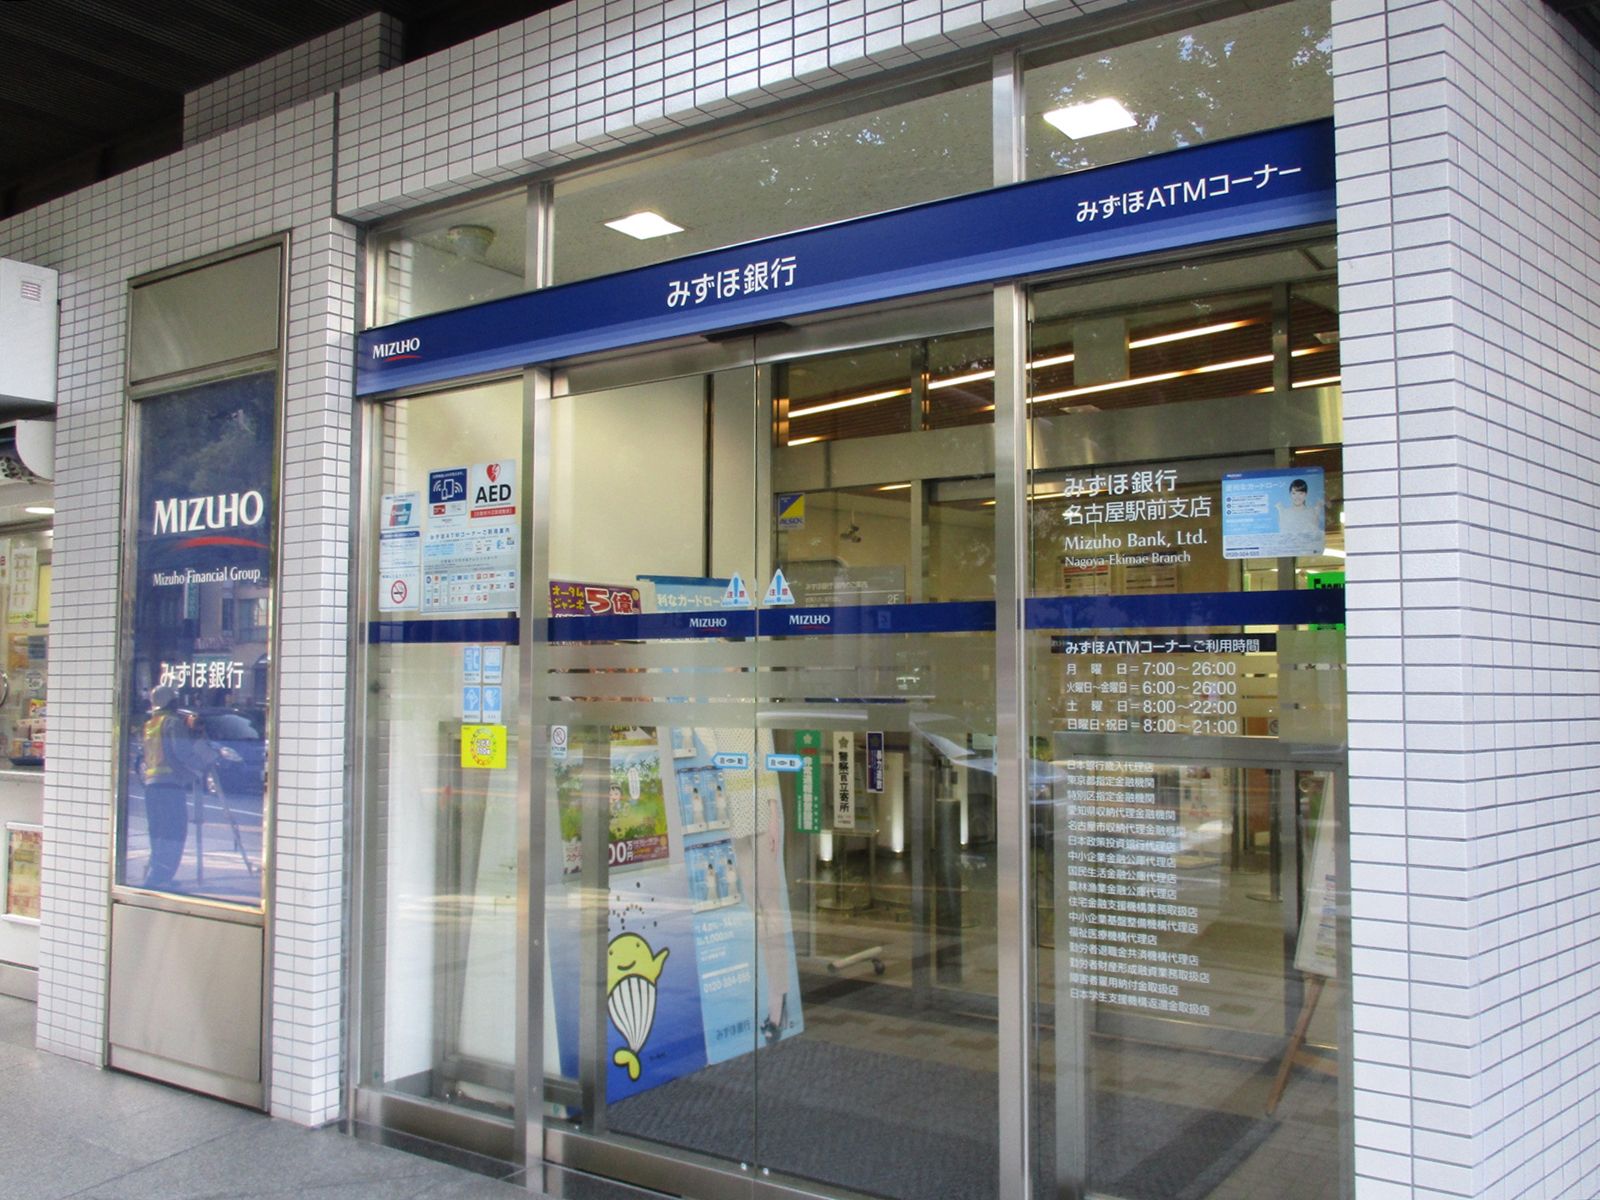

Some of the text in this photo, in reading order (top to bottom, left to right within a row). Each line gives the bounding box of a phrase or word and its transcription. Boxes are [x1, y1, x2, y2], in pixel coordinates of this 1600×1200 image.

[1075, 163, 1302, 223] みずほATMコーナー
[666, 256, 797, 308] みずほ銀行
[372, 337, 421, 360] MIZUHO
[475, 483, 512, 504] AED
[1064, 469, 1178, 499] みずほ銀行
[153, 490, 264, 536] MIZUHO
[1063, 496, 1212, 526] 名古屋駅前支店
[1064, 535, 1122, 551] Mizuho
[1127, 533, 1172, 549] Bank,
[1177, 529, 1208, 545] Ltd.
[1064, 552, 1191, 568] Nagoya-Ekimae Branch
[153, 566, 261, 587] Mizuho Financial Group
[552, 586, 585, 598] オータム
[552, 598, 585, 610] ジャンボ
[689, 617, 728, 628] MIZUHO
[789, 614, 831, 626] MIZUHO
[1065, 638, 1260, 655] みずほATMコーナーご利用時間
[160, 661, 244, 689] みずほ銀行
